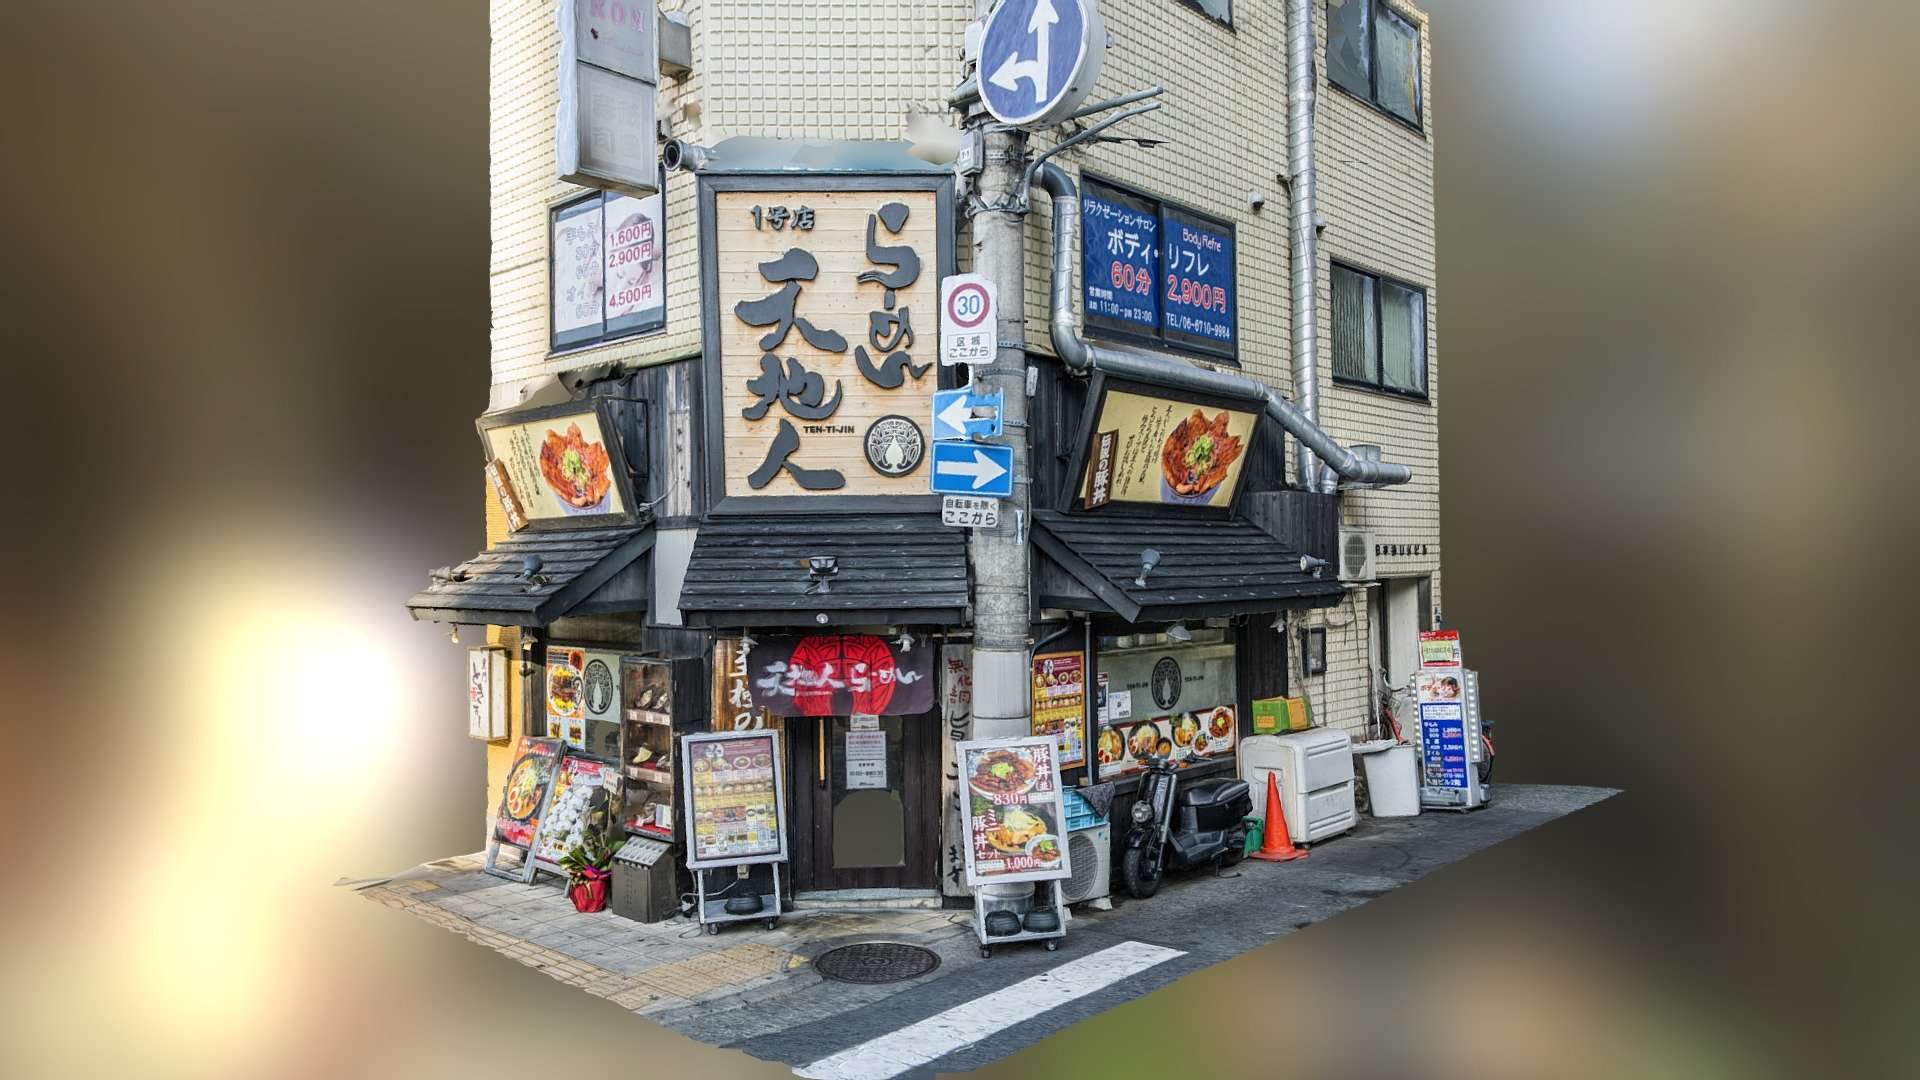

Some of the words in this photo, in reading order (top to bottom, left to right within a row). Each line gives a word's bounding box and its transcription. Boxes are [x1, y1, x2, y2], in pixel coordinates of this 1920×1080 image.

[750, 205, 816, 231] 1号店
[1083, 200, 1157, 233] リラクゼーションサロン
[1168, 243, 1210, 276] リフレ
[855, 201, 934, 389] らーめん
[1111, 261, 1152, 296] 60分
[1167, 274, 1226, 314] 2,900円
[957, 295, 980, 316] 30
[949, 346, 989, 358] ここから
[734, 247, 849, 491] 天地人
[803, 425, 855, 434] TEN-TI-JIN
[944, 498, 997, 510] 自転車を除く
[944, 511, 998, 525] ここから
[993, 793, 1028, 806] 830円
[972, 815, 988, 850] 豚丼
[1006, 857, 1041, 870] 1,000円
